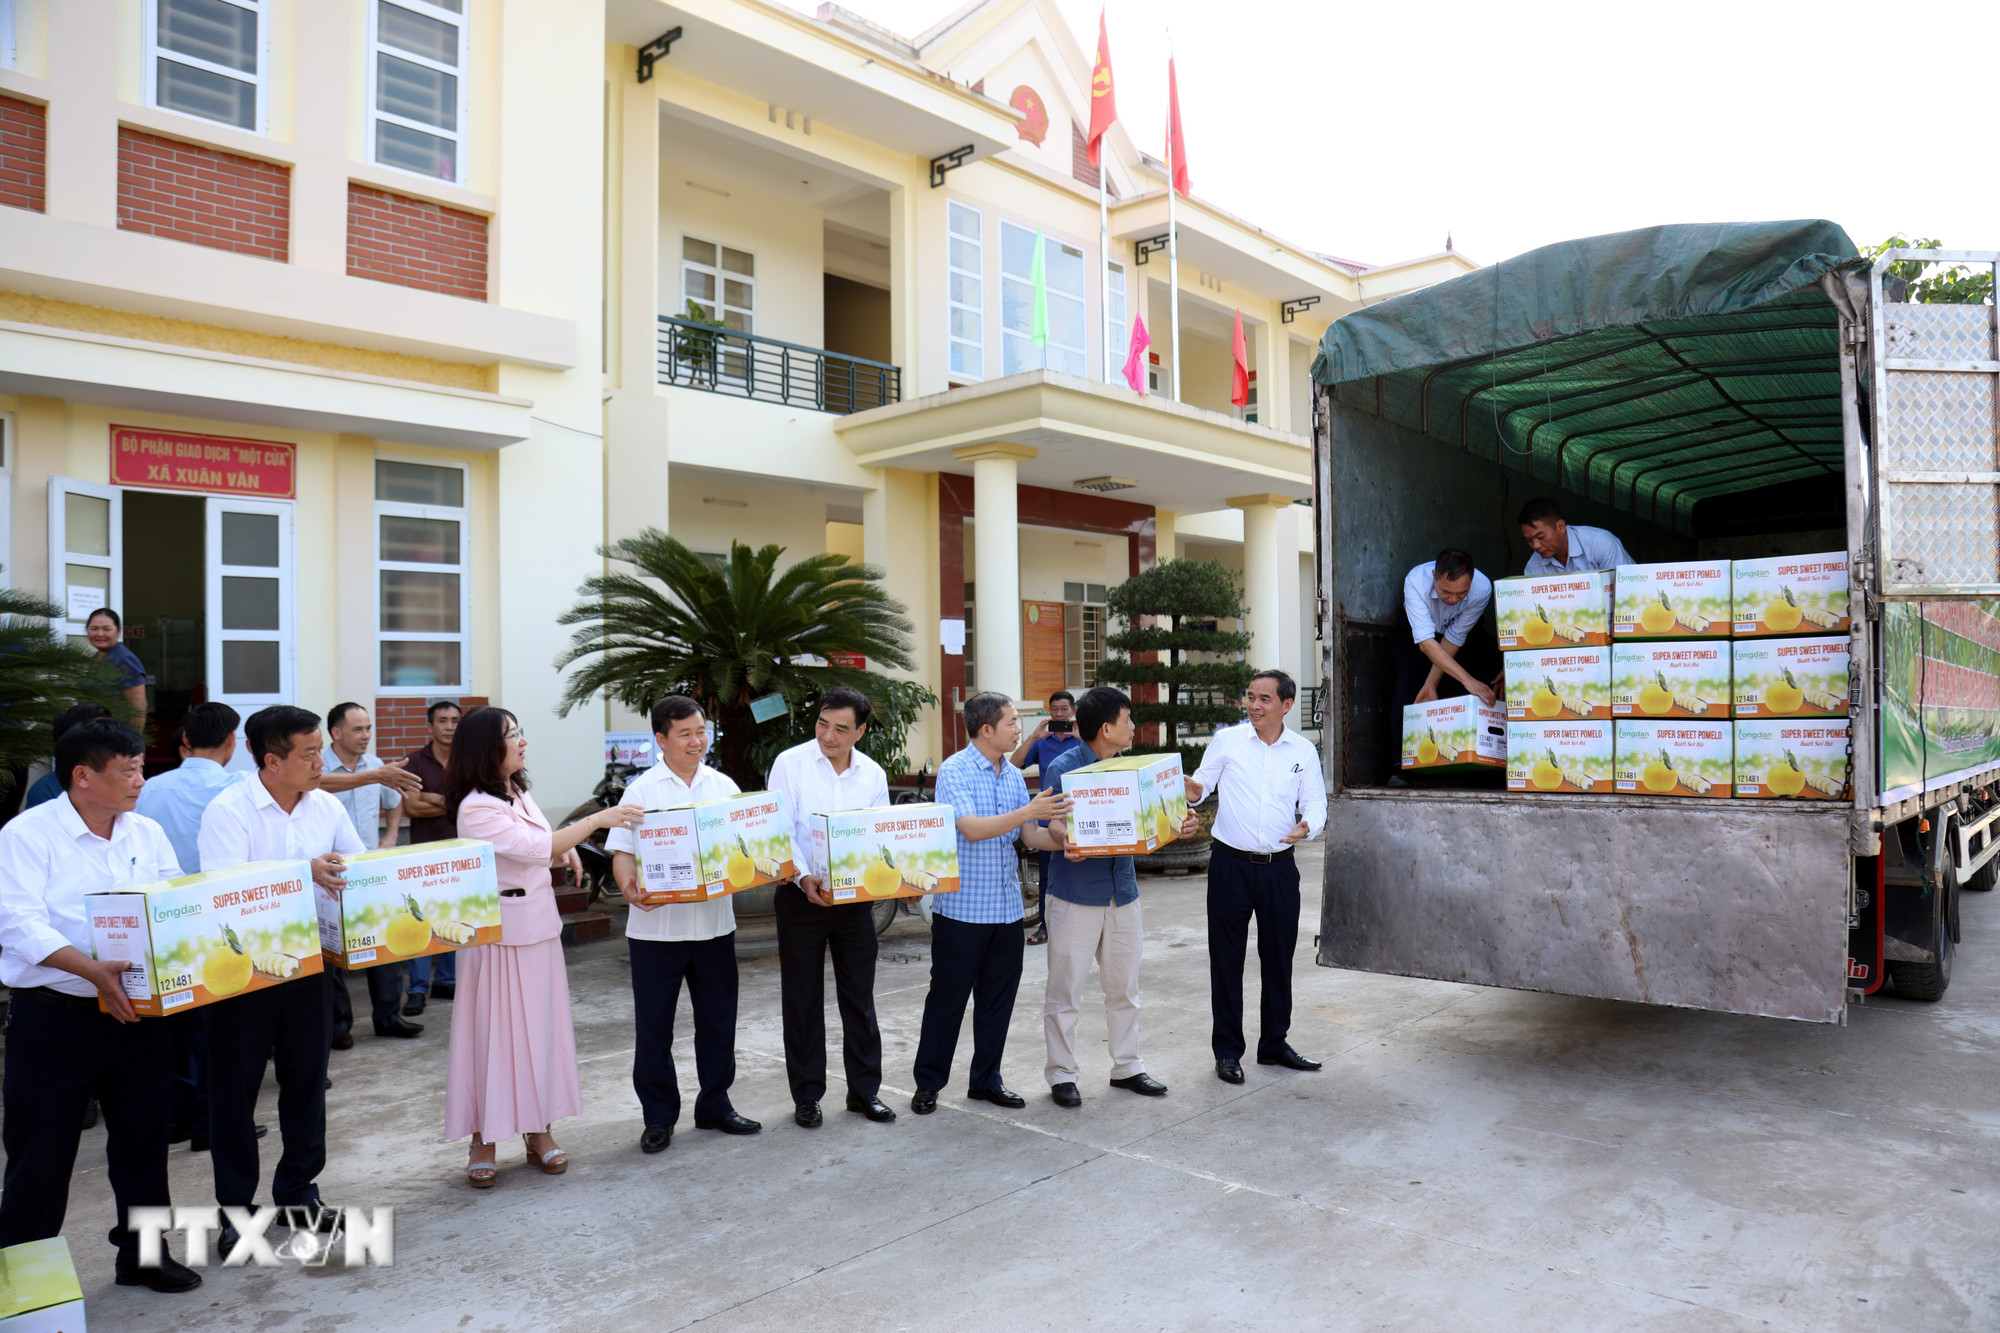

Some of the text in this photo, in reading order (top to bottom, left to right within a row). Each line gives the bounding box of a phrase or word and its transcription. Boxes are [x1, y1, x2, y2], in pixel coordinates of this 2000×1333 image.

[122, 435, 138, 456] BỘ
[140, 438, 172, 458] PHẬN
[176, 442, 200, 459] GIAO
[204, 446, 230, 464] DỊCH
[148, 464, 171, 482] XÃ
[176, 467, 222, 486] XUÂN
[1656, 569, 1721, 580] SUPER SWEET POMELO
[1735, 568, 1770, 580] Longdan
[1778, 565, 1798, 576] SUPER
[1800, 563, 1821, 574] SWEET
[1618, 572, 1648, 582] Longdan
[1496, 588, 1524, 598] Longdan
[1531, 581, 1590, 594] SUPER SWEET POMELO
[1734, 613, 1756, 621] 121481
[1614, 652, 1645, 662] Longdan
[1652, 650, 1718, 660] SUPER SWEET POMELO
[1735, 650, 1768, 660] Longdan
[1777, 647, 1798, 657] SUPER
[1800, 645, 1820, 656] SWEET
[1506, 659, 1534, 669] Longdan
[1540, 656, 1600, 666] SUPER SWEET POMELO
[1426, 704, 1466, 718] SUPER SWEET POMELO
[1478, 708, 1489, 717] SUPER
[1490, 710, 1500, 718] SWEET
[1509, 729, 1536, 739] Longdan
[1544, 730, 1602, 738] SUPER SWEET POMELO
[1618, 728, 1650, 739] Longdan
[1657, 730, 1722, 740] SUPER SWEET POMELO
[1739, 729, 1772, 740] Longdan
[1780, 730, 1802, 738] SUPER
[1802, 730, 1823, 738] SWEET
[1072, 786, 1130, 798] SUPER SWEET POMELO
[730, 802, 778, 822] SUPER SWEET POMELO
[698, 816, 725, 830] Longdan
[874, 817, 945, 833] SUPER SWEET POMELO
[1078, 820, 1100, 829] 121481
[640, 826, 688, 840] SUPER SWEET POMELO
[831, 826, 866, 838] Longdan
[398, 857, 481, 881] SUPER SWEET POMELO
[646, 864, 665, 872] 121481
[704, 870, 723, 882] 121481
[343, 874, 388, 891] Longdan
[832, 877, 856, 888] 121481
[212, 891, 241, 910] SUPER
[242, 885, 269, 904] SWEET
[270, 878, 302, 897] POMELO
[154, 903, 202, 924] Longdan
[94, 916, 140, 928] SUPER SWEET POMELO
[348, 935, 376, 950] 121481
[160, 974, 192, 992] 121481
